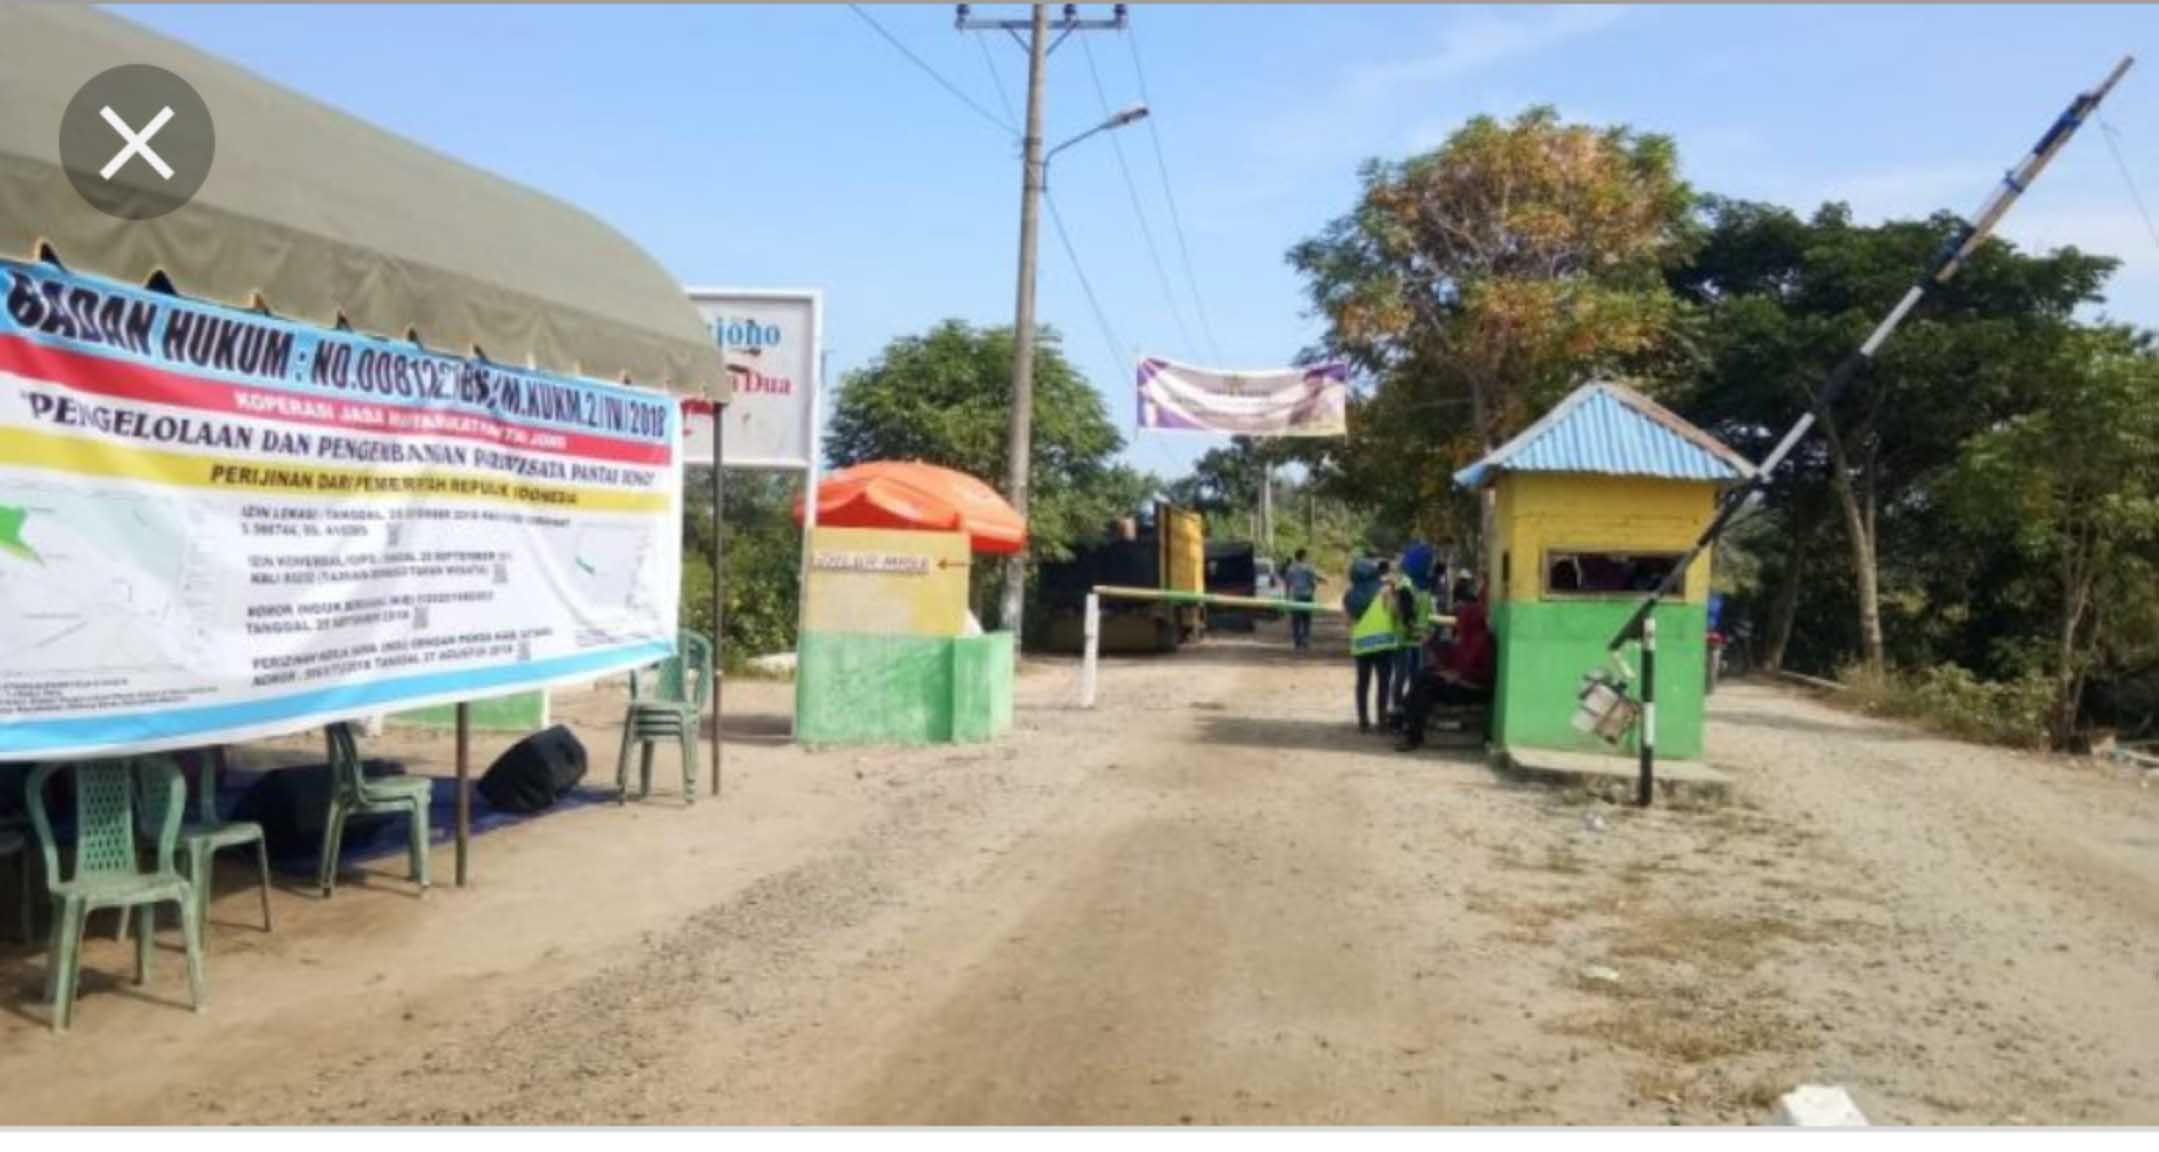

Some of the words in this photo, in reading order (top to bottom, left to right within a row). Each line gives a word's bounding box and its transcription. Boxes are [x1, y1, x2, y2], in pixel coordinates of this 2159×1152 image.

[7, 272, 157, 354] BADAN
[163, 308, 295, 384] HUKUM
[234, 390, 335, 421] KOPERASI
[261, 428, 309, 455] DAN
[210, 464, 313, 490] PERIJINAN
